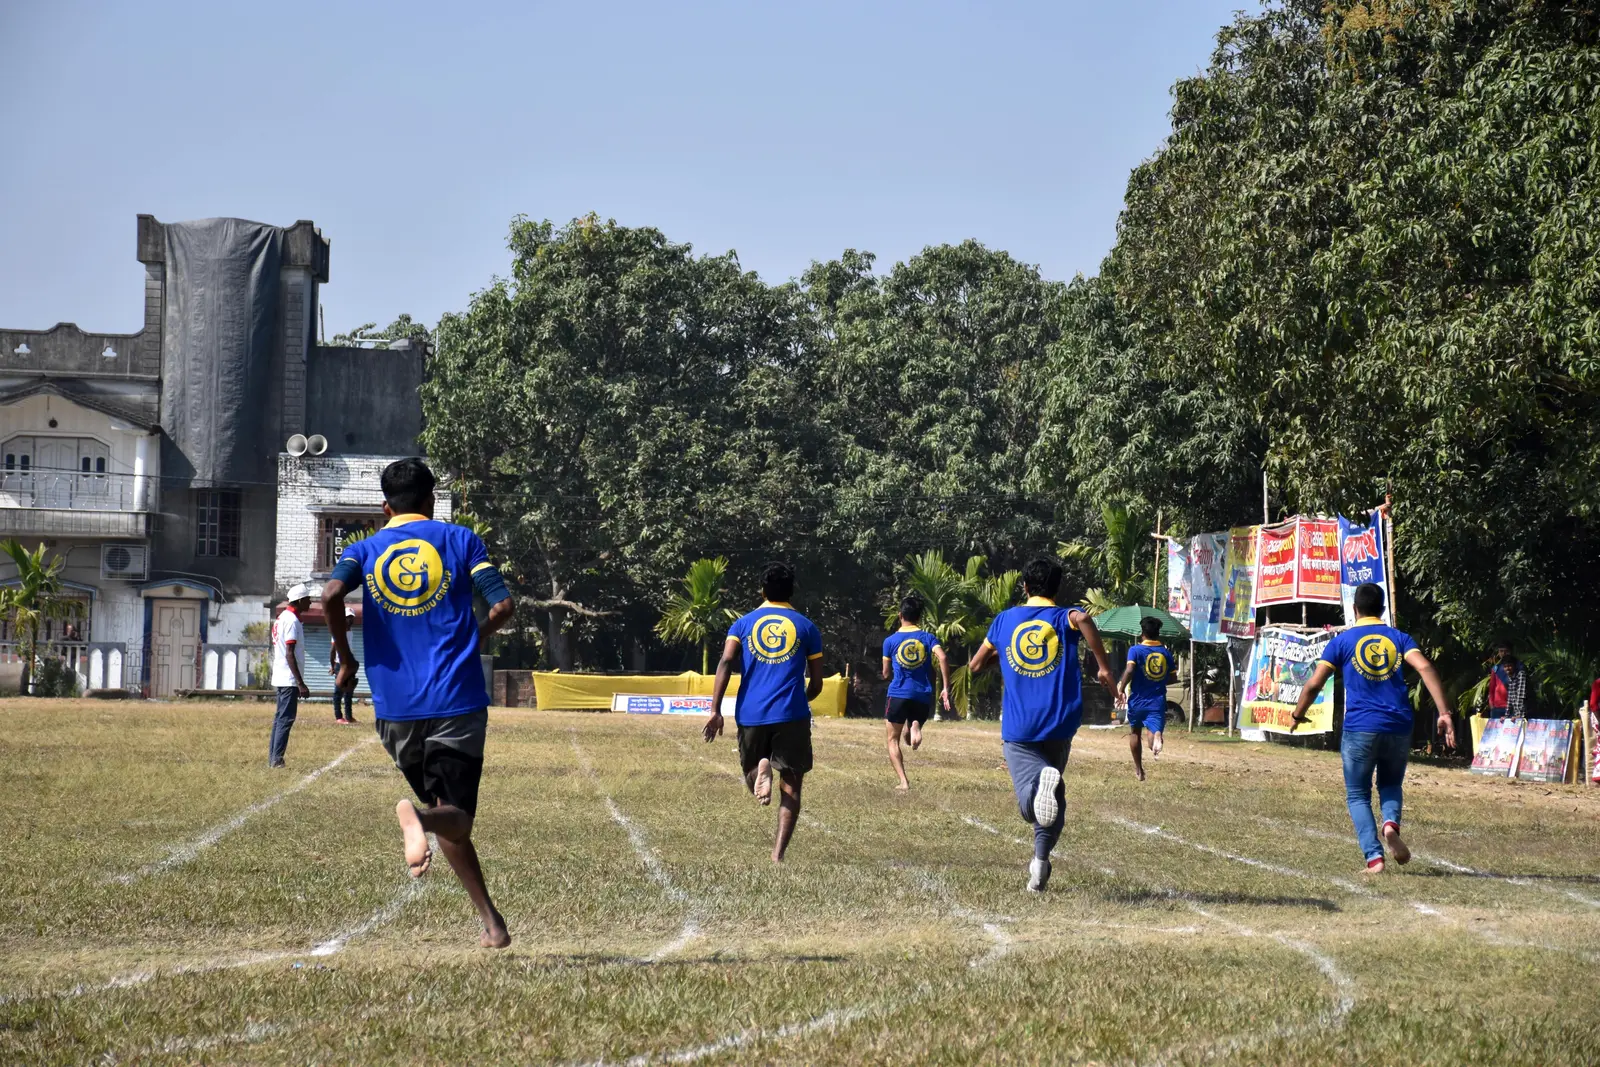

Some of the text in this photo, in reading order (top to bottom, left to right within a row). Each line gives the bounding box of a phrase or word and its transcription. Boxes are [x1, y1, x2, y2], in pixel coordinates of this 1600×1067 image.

[365, 570, 452, 616] GENEX SUPTENDUU GROUP
[747, 635, 757, 655] GENEX
[788, 638, 801, 657] GROUP
[1005, 646, 1016, 668] GENEX
[1014, 665, 1055, 678] SUPTENDUU
[1351, 657, 1364, 675] GENEX
[1392, 652, 1403, 672] GROUP
